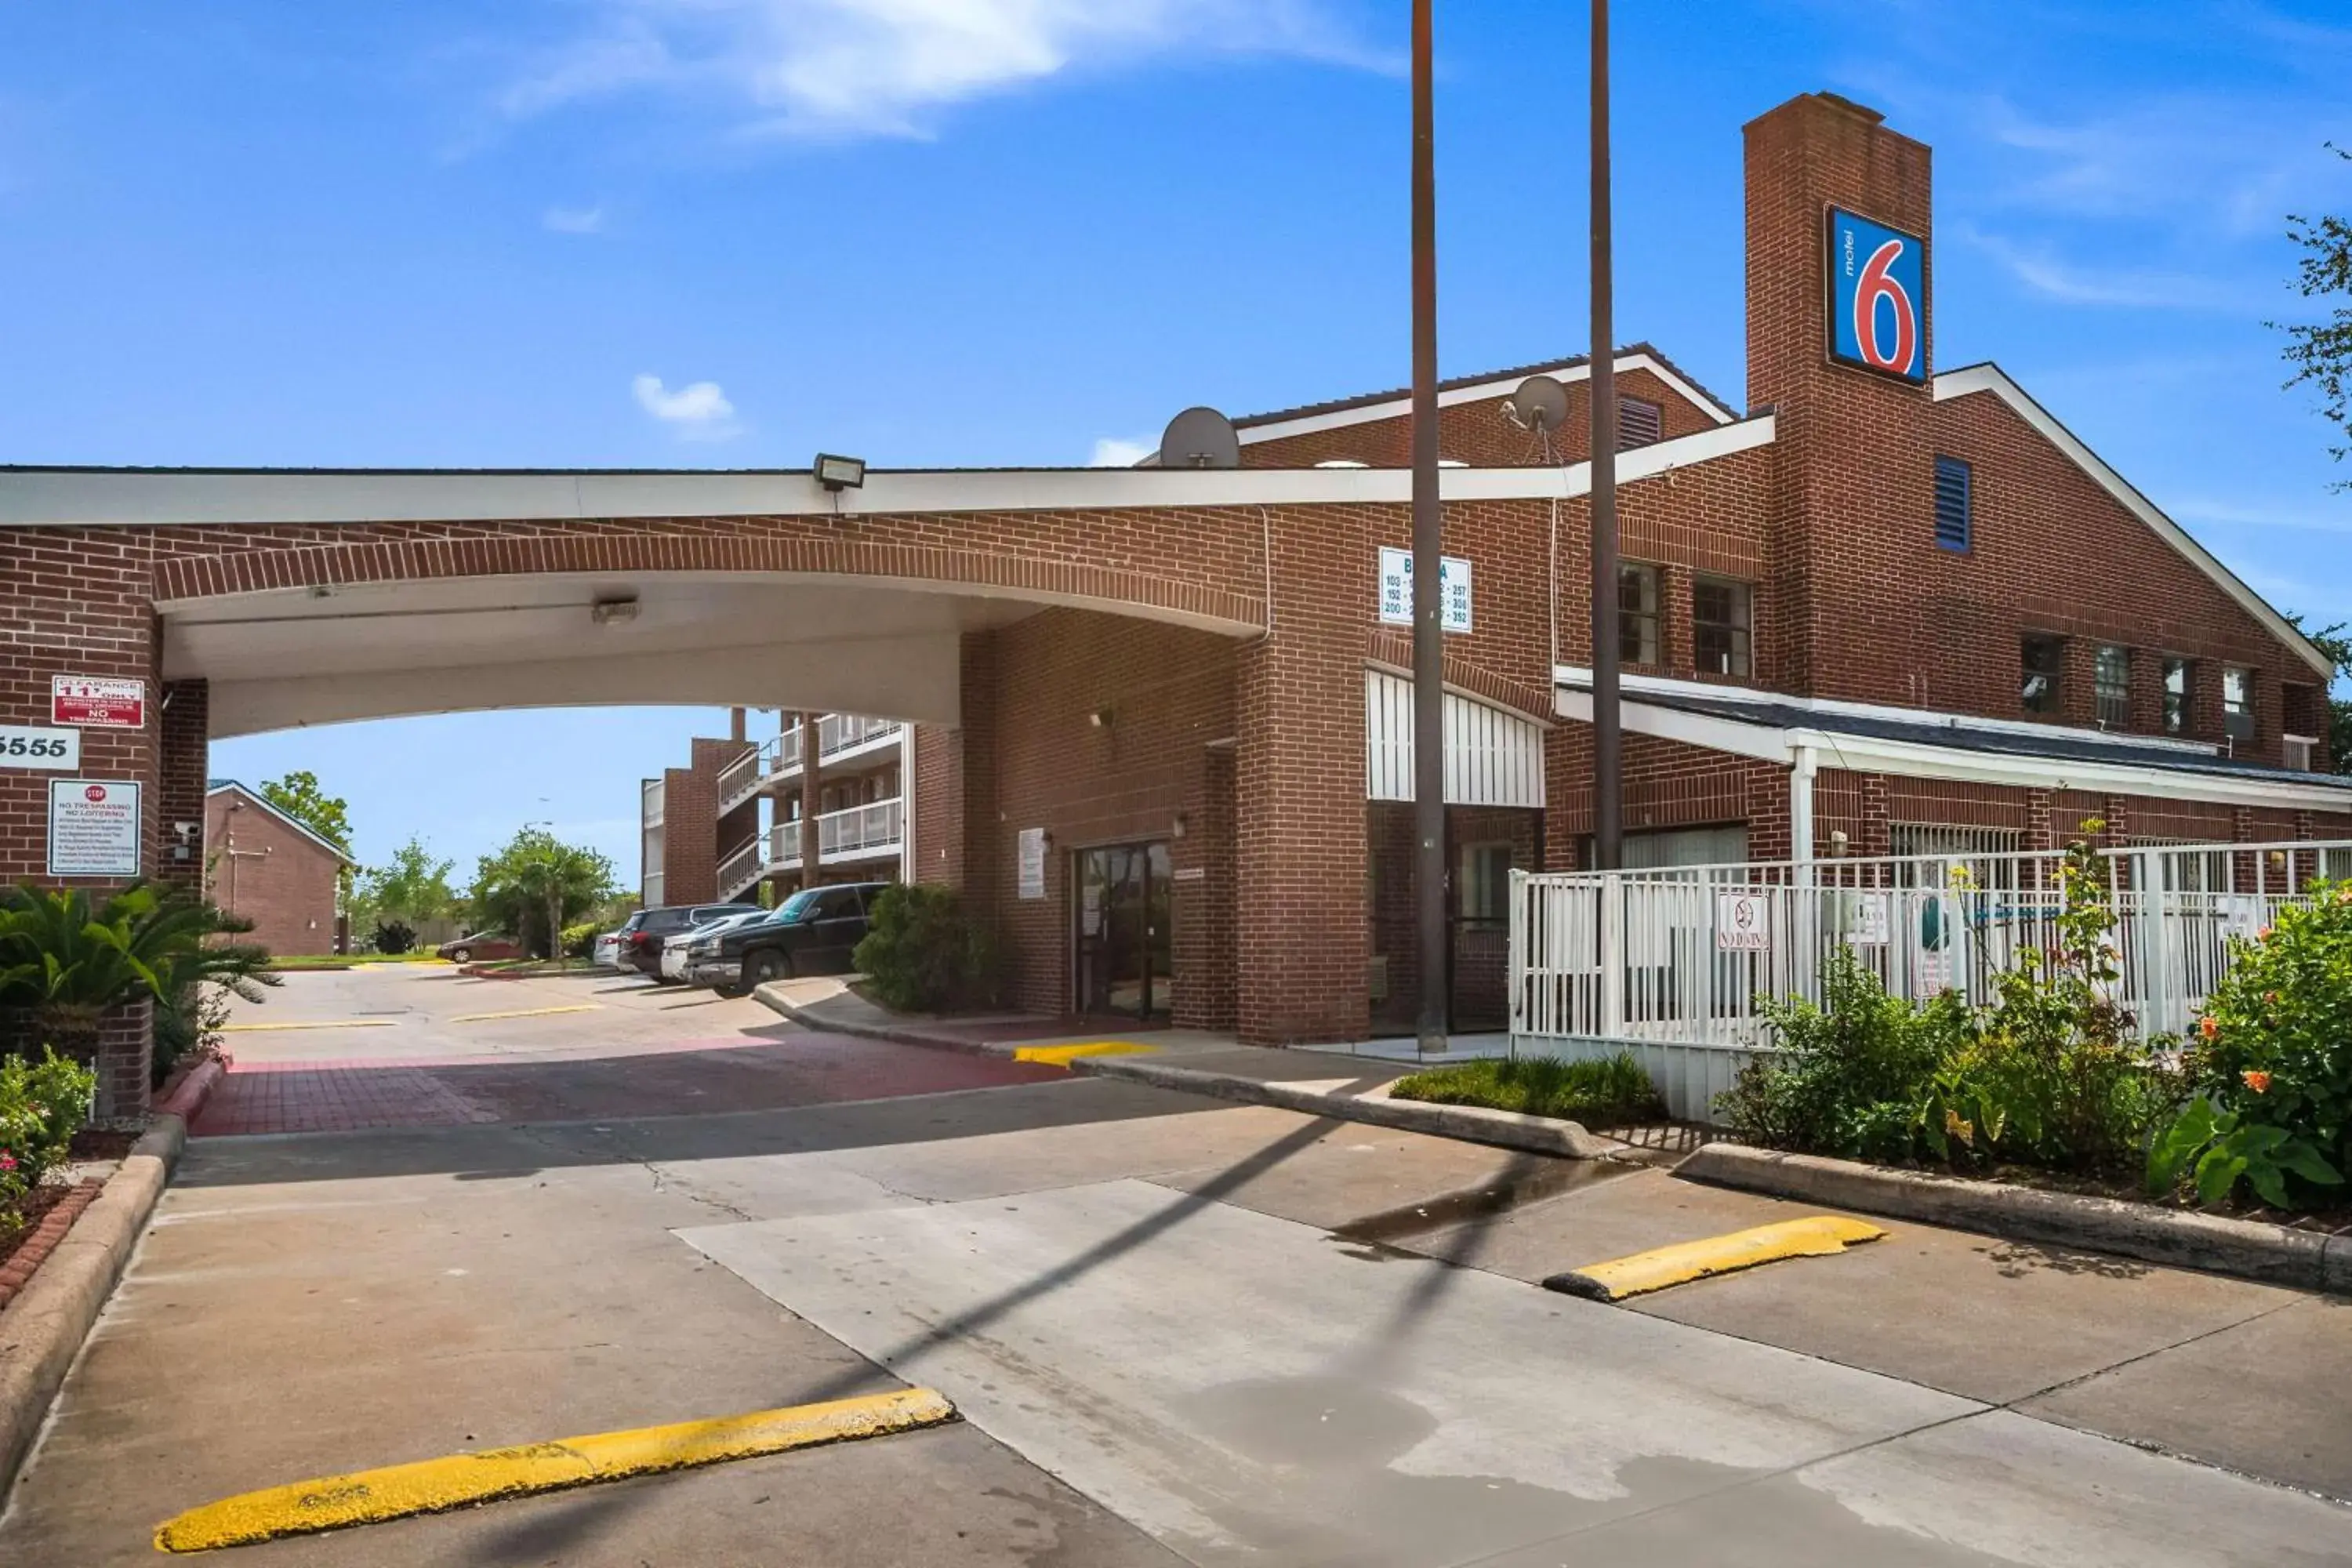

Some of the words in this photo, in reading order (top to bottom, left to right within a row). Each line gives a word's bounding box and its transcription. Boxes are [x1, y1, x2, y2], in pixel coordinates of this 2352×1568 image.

[1844, 230, 1854, 277] motel
[1853, 239, 1916, 375] 6
[1439, 564, 1448, 579] A
[1386, 575, 1401, 587] 103
[1387, 589, 1400, 601] 152
[1453, 584, 1466, 597] 257
[1385, 601, 1401, 614] 200
[1453, 612, 1467, 623] 352
[60, 679, 136, 689] CLEARANCE
[87, 789, 104, 798] STOP
